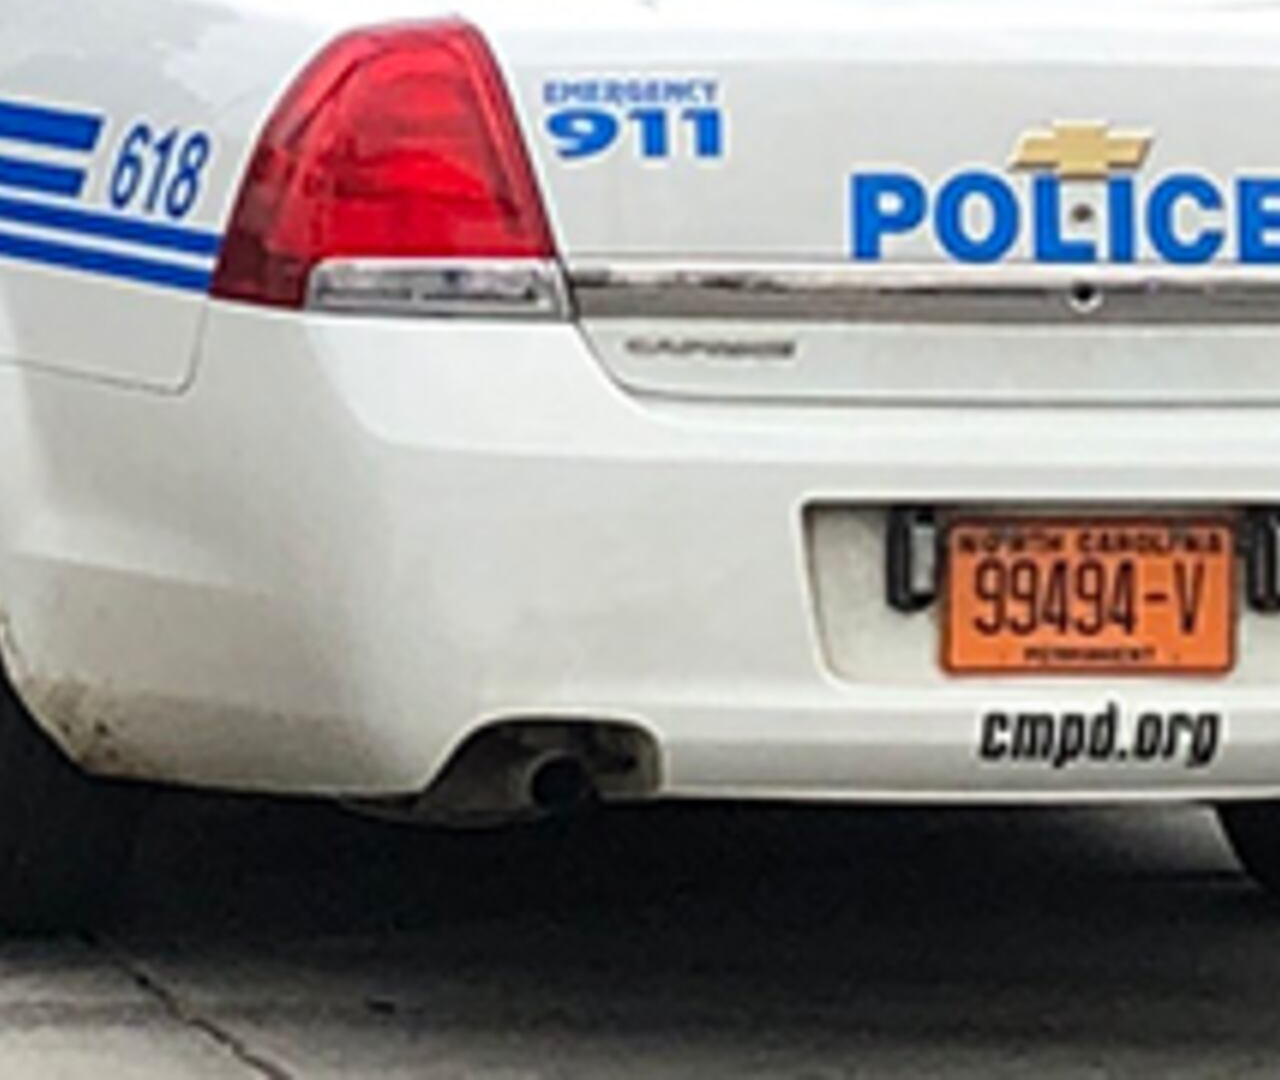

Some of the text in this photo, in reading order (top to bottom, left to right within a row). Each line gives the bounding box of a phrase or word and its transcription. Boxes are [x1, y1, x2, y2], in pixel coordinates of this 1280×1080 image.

[543, 79, 719, 104] EMERGENCY
[546, 107, 723, 159] 911
[110, 123, 210, 218] 618
[958, 531, 1224, 557] NORTH CAROLINA
[973, 557, 1207, 637] 99494-V
[978, 703, 1221, 767] cmpd.org
